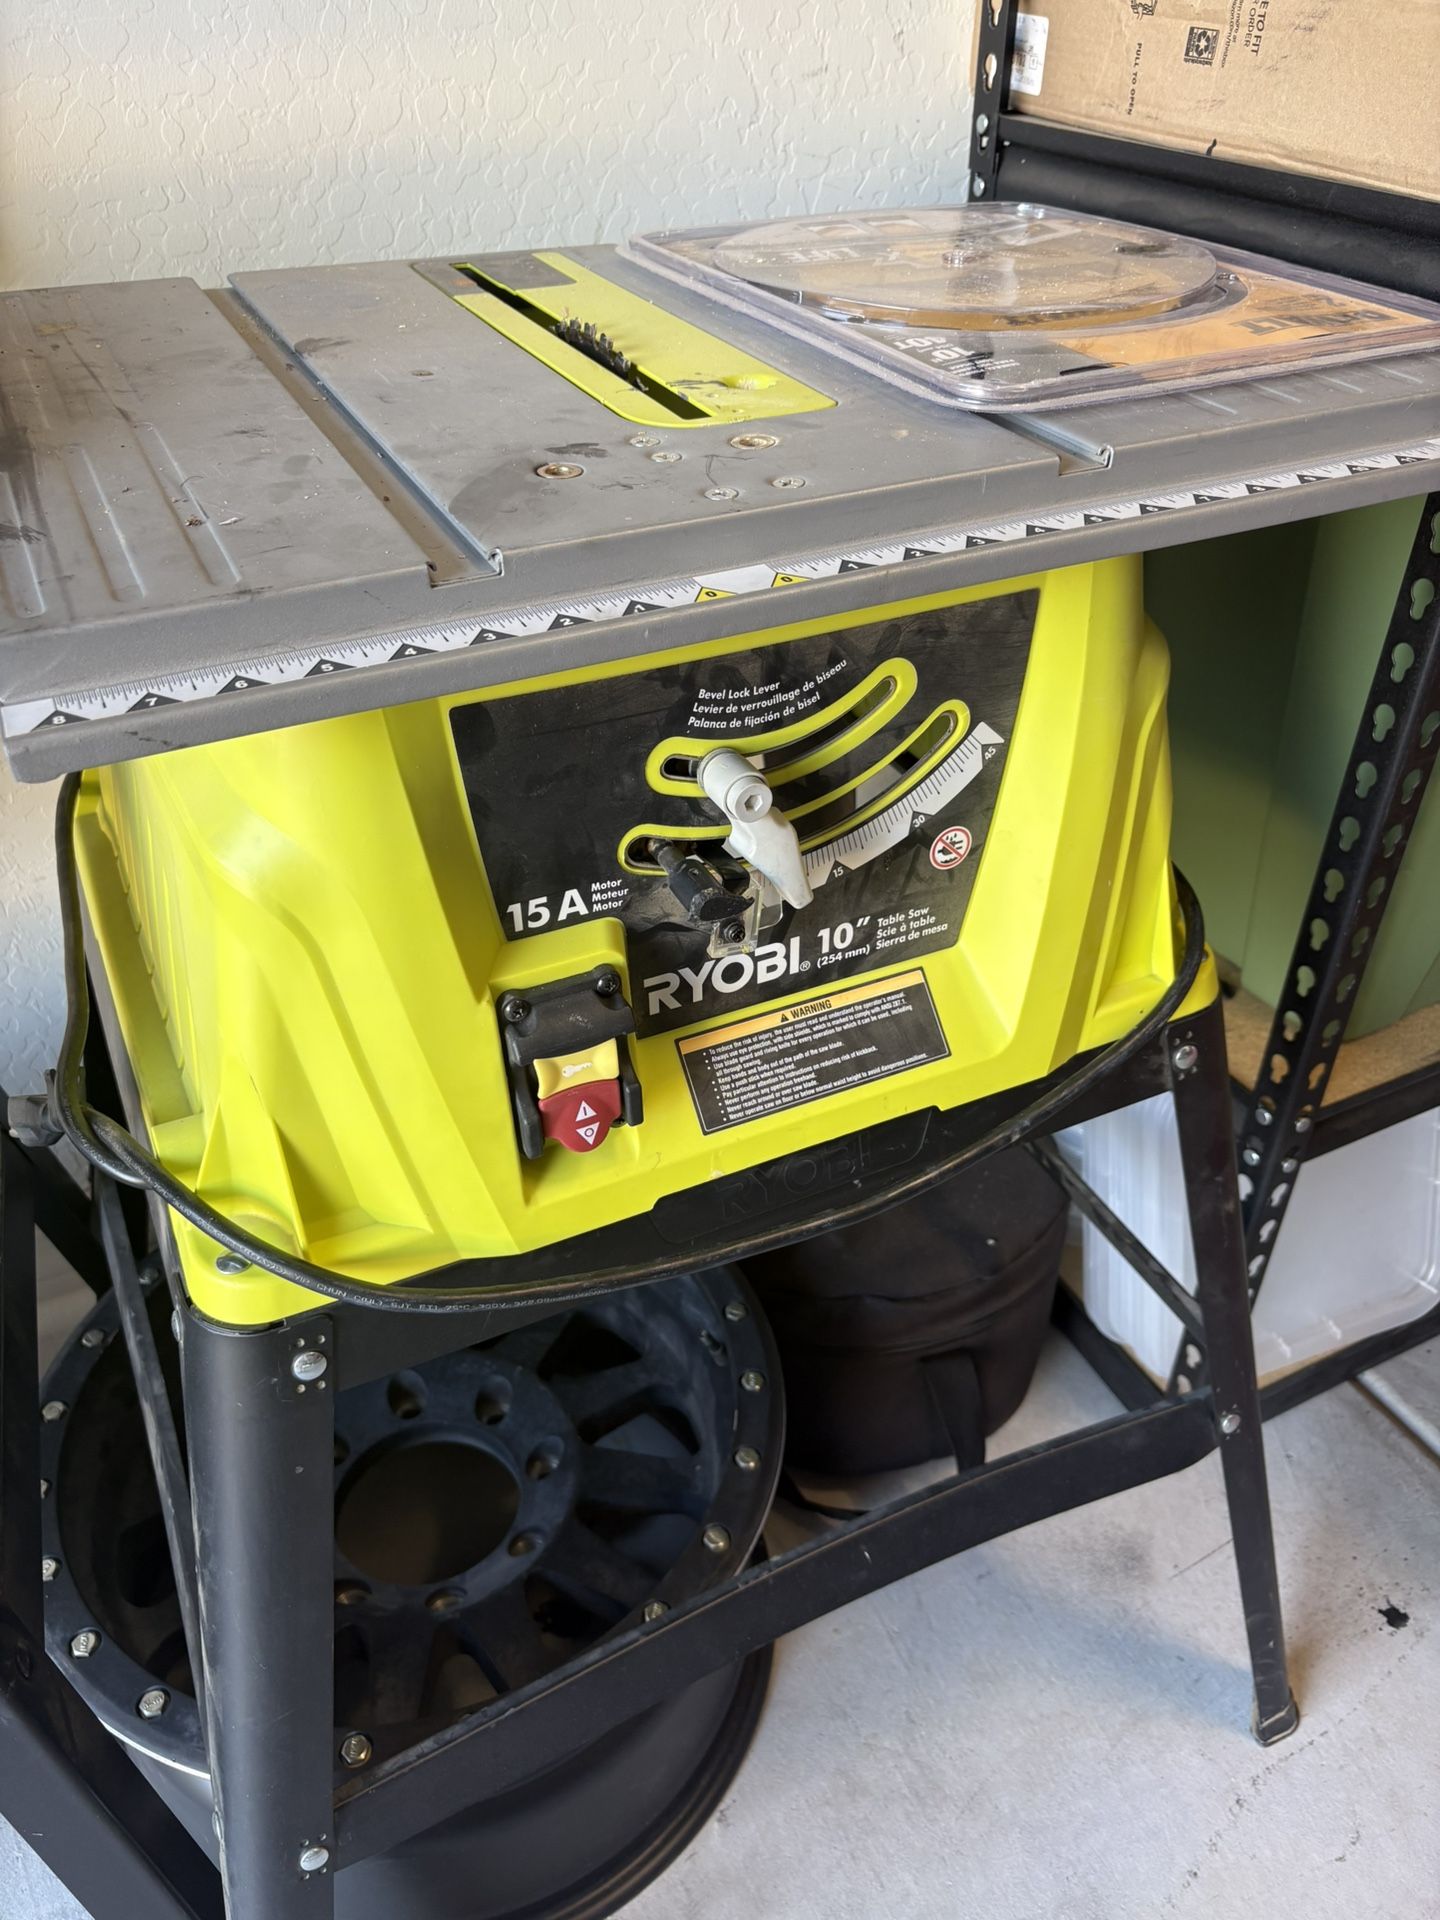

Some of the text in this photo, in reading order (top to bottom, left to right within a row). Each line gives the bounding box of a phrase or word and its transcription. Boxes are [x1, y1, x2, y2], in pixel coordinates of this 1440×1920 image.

[1244, 8, 1256, 47] ORDER
[1256, 11, 1266, 32] TO
[1251, 35, 1262, 56] FIT
[1126, 42, 1142, 115] PULL TO OPEN
[52, 716, 66, 724] 8
[146, 697, 158, 706] 7
[234, 680, 248, 688] 6
[321, 662, 334, 672] 5
[404, 648, 417, 656] 4
[484, 632, 496, 640] 3
[560, 617, 574, 626] 2
[693, 659, 848, 714] Levier de verrouillage de biseau
[698, 682, 780, 700] Bevel Lock Lever
[688, 692, 821, 728] Palanca de fijación de bisel
[984, 746, 996, 760] 45
[913, 814, 926, 828] 30
[832, 866, 844, 878] 15
[591, 879, 622, 892] Motor
[592, 888, 629, 902] Moteur
[506, 888, 590, 932] 15 A
[592, 900, 624, 912] Motor
[876, 906, 930, 928] Table Saw
[817, 916, 870, 954] 10"
[876, 915, 936, 938] Scie à table
[876, 923, 948, 950] Sierra de mesa
[816, 944, 870, 968] (254 mm)
[790, 1000, 832, 1019] WARNING
[715, 1043, 733, 1053] reduce
[733, 1040, 741, 1048] the
[742, 1037, 752, 1045] risk
[758, 1031, 773, 1041] injury,
[782, 1025, 793, 1033] user
[793, 1021, 806, 1029] must
[806, 1017, 818, 1025] read
[818, 1014, 827, 1022] and
[827, 1006, 854, 1019] understand
[862, 997, 886, 1010] operator's
[886, 991, 906, 1001] manual.
[717, 1075, 731, 1086] Keep
[731, 1070, 747, 1080] hands
[747, 1067, 757, 1075] and
[757, 1063, 770, 1073] body
[784, 1056, 792, 1064] the
[792, 1053, 804, 1062] path
[809, 1048, 818, 1056] the
[828, 1040, 844, 1050] blade.
[719, 1063, 796, 1092] Use push stick when required.
[316, 1284, 346, 1298] CHUN
